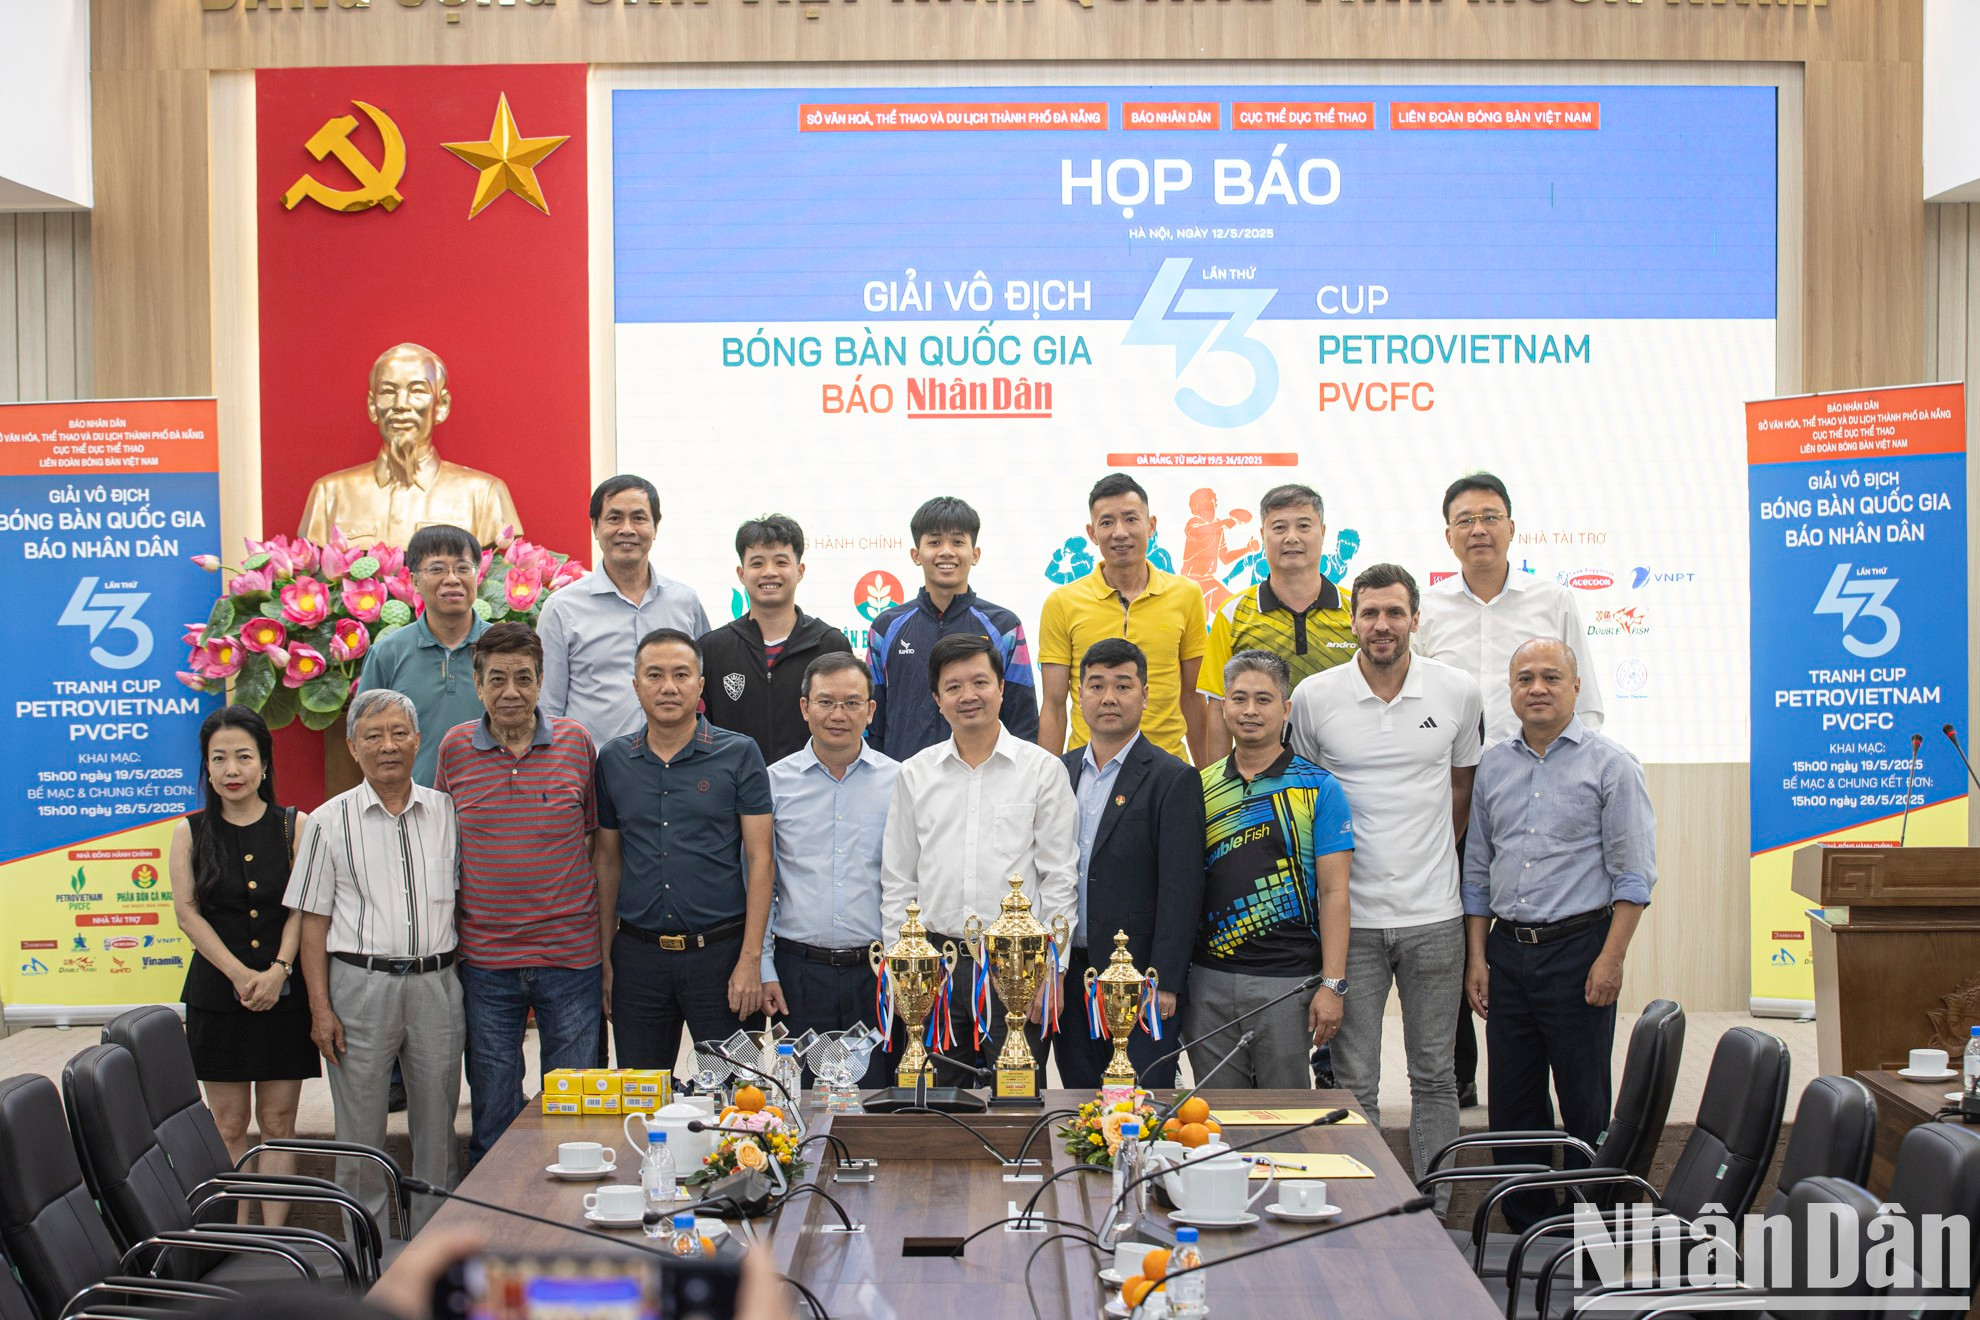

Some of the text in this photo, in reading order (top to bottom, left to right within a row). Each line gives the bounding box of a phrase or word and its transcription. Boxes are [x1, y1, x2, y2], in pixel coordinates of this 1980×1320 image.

[807, 109, 1101, 126] SỞ VĂN HOÁ, THỂ THAO VÀ DU LỊCH THÀNH PHỐ ĐÀ NẴNG
[1131, 109, 1211, 124] BÁO NHÂN DÂN
[1240, 107, 1367, 125] CỤC THỂ DỤC THỂ THAO
[1398, 109, 1592, 125] LIÊN ĐOÀN BÓNG BÀN VIỆT NAM
[1061, 143, 1341, 220] HỌP BÁO
[1129, 226, 1275, 241] HÀ NỘI, NGÀY 12/5/2025
[1202, 266, 1257, 280] LẦN THỨ
[862, 268, 1092, 320] GIẢI VÔ ĐỊCH
[1316, 285, 1390, 314] CUP
[722, 319, 1092, 369] BÓNG BÀN QUỐC GIA
[1319, 333, 1591, 364] PETROVIETNAM
[821, 374, 894, 414] BÁO
[1319, 382, 1435, 412] PVCFC
[1827, 400, 1879, 413] BÁO NHÂN DÂN
[69, 418, 126, 428] BÁO NHÂN DÂN
[1758, 408, 1951, 430] SỞ VĂN HÓA, THỂ THAO VÀ DU LỊCH THÀNH PHỐ ĐÀ NẴNG
[1800, 439, 1907, 454] LIÊN ĐOÀN BÓNG BÀN VIỆT NAM
[1137, 454, 1263, 466] ĐÀ NẴNG, TỪ NGÀY 19/5-26/5/2025
[1808, 469, 1899, 490] GIẢI VÔ ĐỊCH
[49, 485, 150, 506] GIẢI VÔ ĐỊCH
[1760, 487, 1951, 520] BÓNG BÀN QUỐC GIA
[59, 507, 101, 530] BÀN
[107, 503, 166, 530] QUỐC
[171, 510, 206, 528] GIA
[1518, 530, 1607, 547] NHÀ TÀI TRỢ
[1786, 519, 1924, 547] BÁO NHÂN DÂN
[24, 534, 178, 559] BÁO NHÂN DÂN
[815, 535, 854, 549] HÀNH
[859, 535, 902, 549] CHÍNH
[1654, 572, 1695, 583] VNPT
[1857, 566, 1888, 576] LẦN THỨ
[1326, 641, 1357, 649] andro
[1809, 667, 1907, 684] TRANH CUP
[53, 679, 161, 695] TRANH CUP
[1775, 686, 1940, 708] PETROVIETNAM
[16, 697, 199, 718] PETROVIETNAM
[1822, 712, 1894, 732] PVCFC
[70, 722, 149, 741] PVCFC
[1830, 742, 1886, 756] KHAI MẠC:
[79, 752, 141, 765] KHAI MẠC:
[1793, 761, 1827, 772] 15h00
[1831, 760, 1858, 774] ngày
[38, 768, 183, 783] 15h00 ngày 19/5/2025
[1783, 775, 1797, 790] BẾ
[1800, 778, 1825, 791] MẠC
[1828, 778, 1836, 789] &
[1838, 777, 1878, 789] CHUNG
[1881, 774, 1902, 788] KẾT
[38, 802, 186, 817] 15h00 ngày 26/5/2025
[1792, 794, 1925, 809] 15h00 ngày 26/5/2025
[1207, 824, 1270, 865] ouble Fish
[56, 893, 103, 902] PETROVIETNAM
[69, 902, 91, 911] PVCFC
[142, 956, 183, 967] Vinamilk
